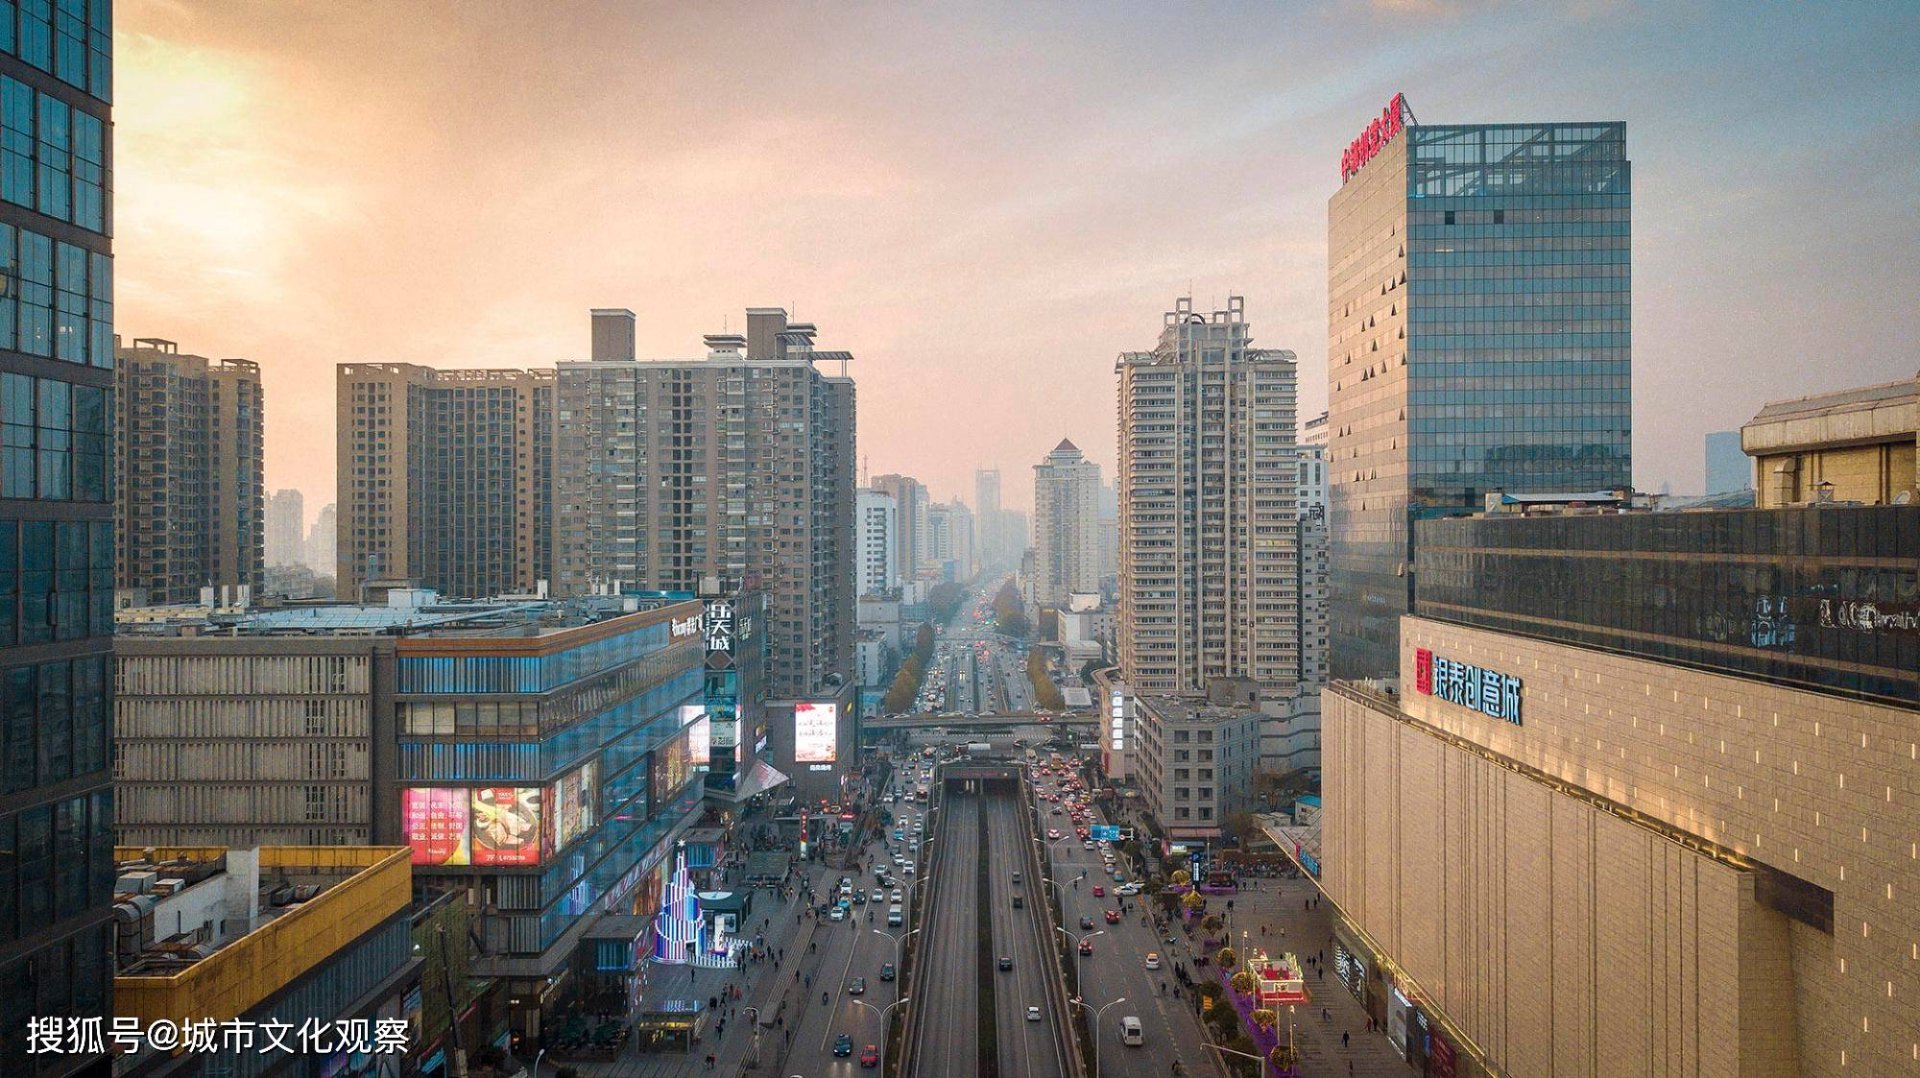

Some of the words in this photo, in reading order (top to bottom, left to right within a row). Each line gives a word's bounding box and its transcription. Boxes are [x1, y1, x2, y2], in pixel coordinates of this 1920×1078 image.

[1433, 655, 1522, 726] 银泰创意城
